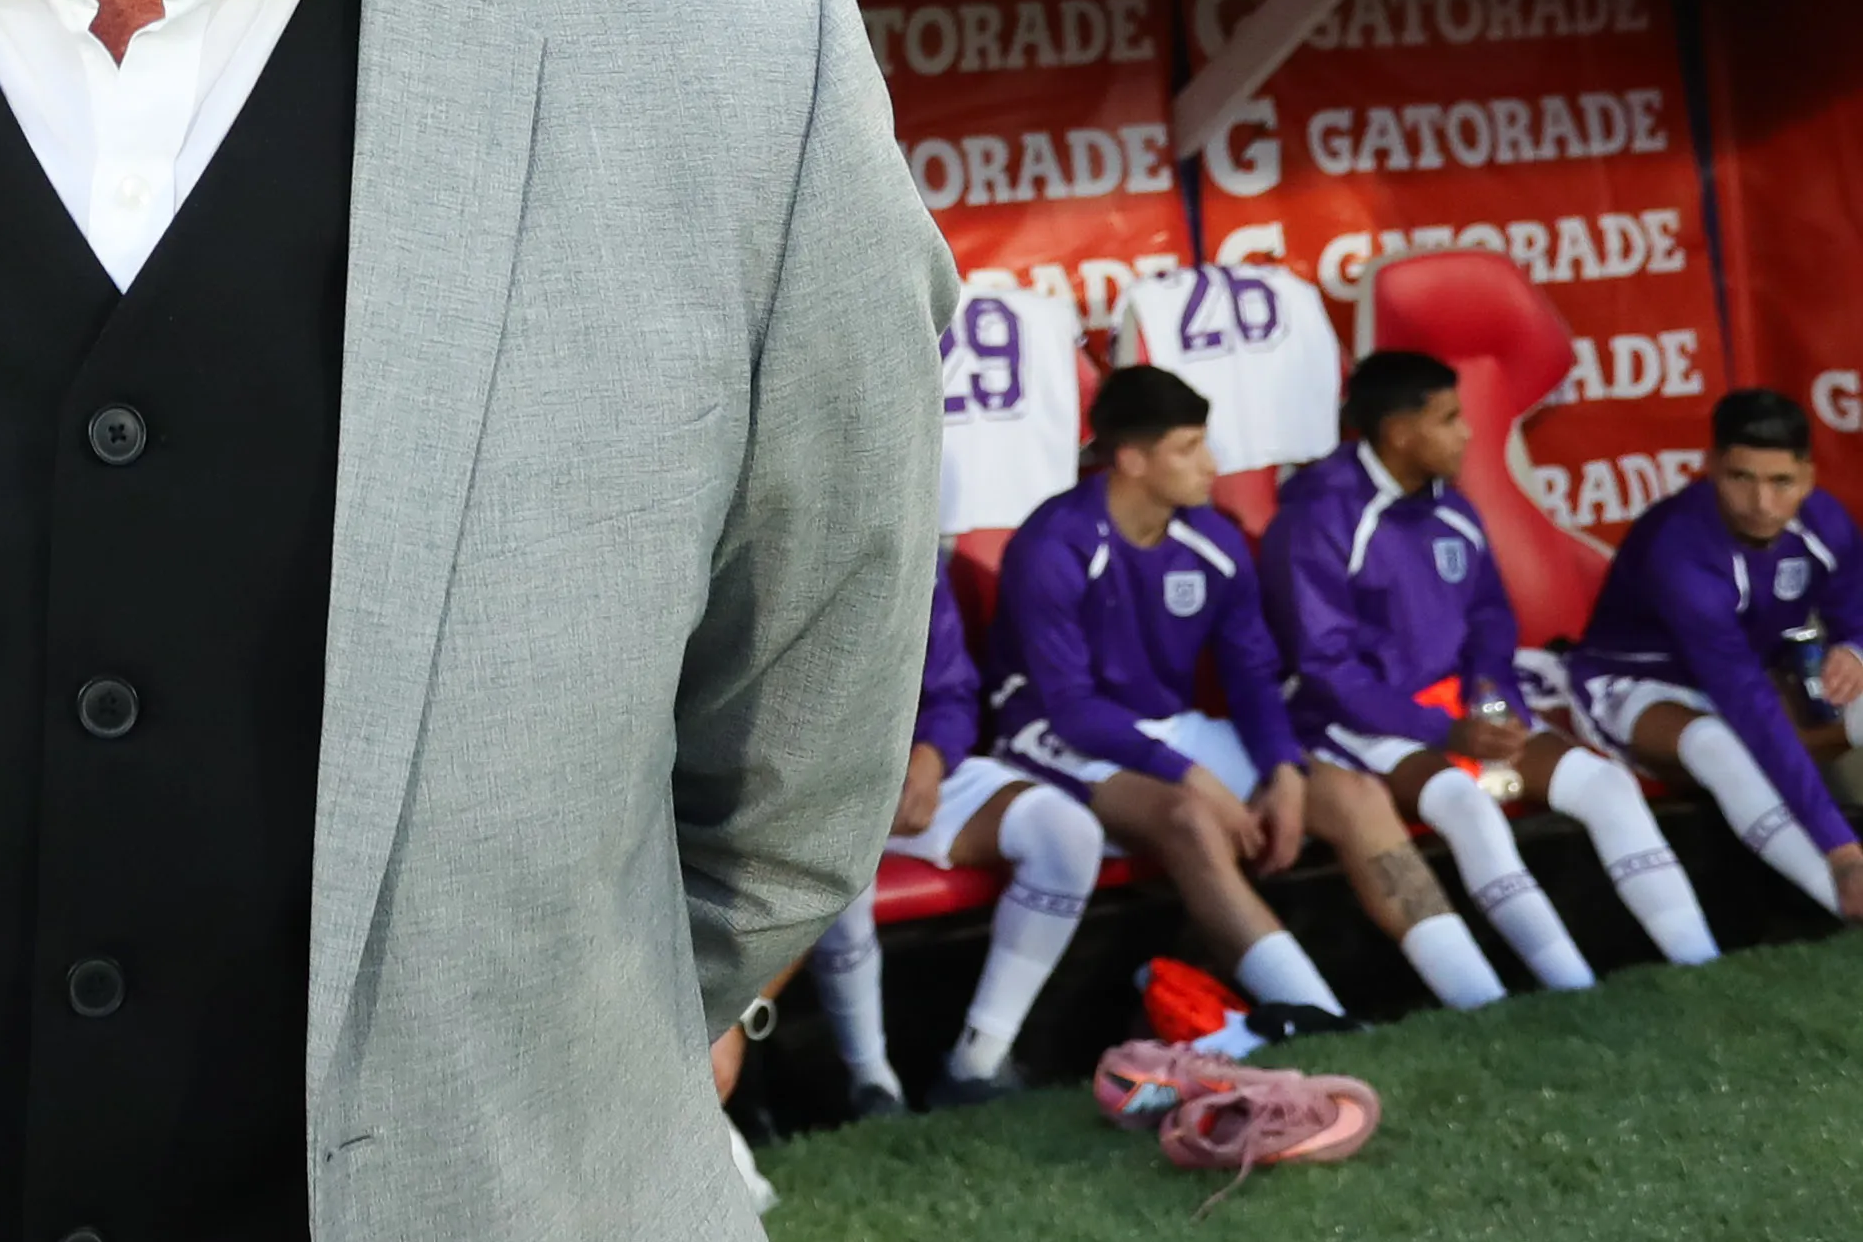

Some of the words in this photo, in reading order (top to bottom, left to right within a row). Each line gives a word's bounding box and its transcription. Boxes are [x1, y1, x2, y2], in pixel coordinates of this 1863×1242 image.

[897, 123, 1174, 210] ORADE
[1204, 96, 1282, 198] G
[1306, 88, 1668, 176] GATORADE
[1547, 329, 1704, 406] ADE
